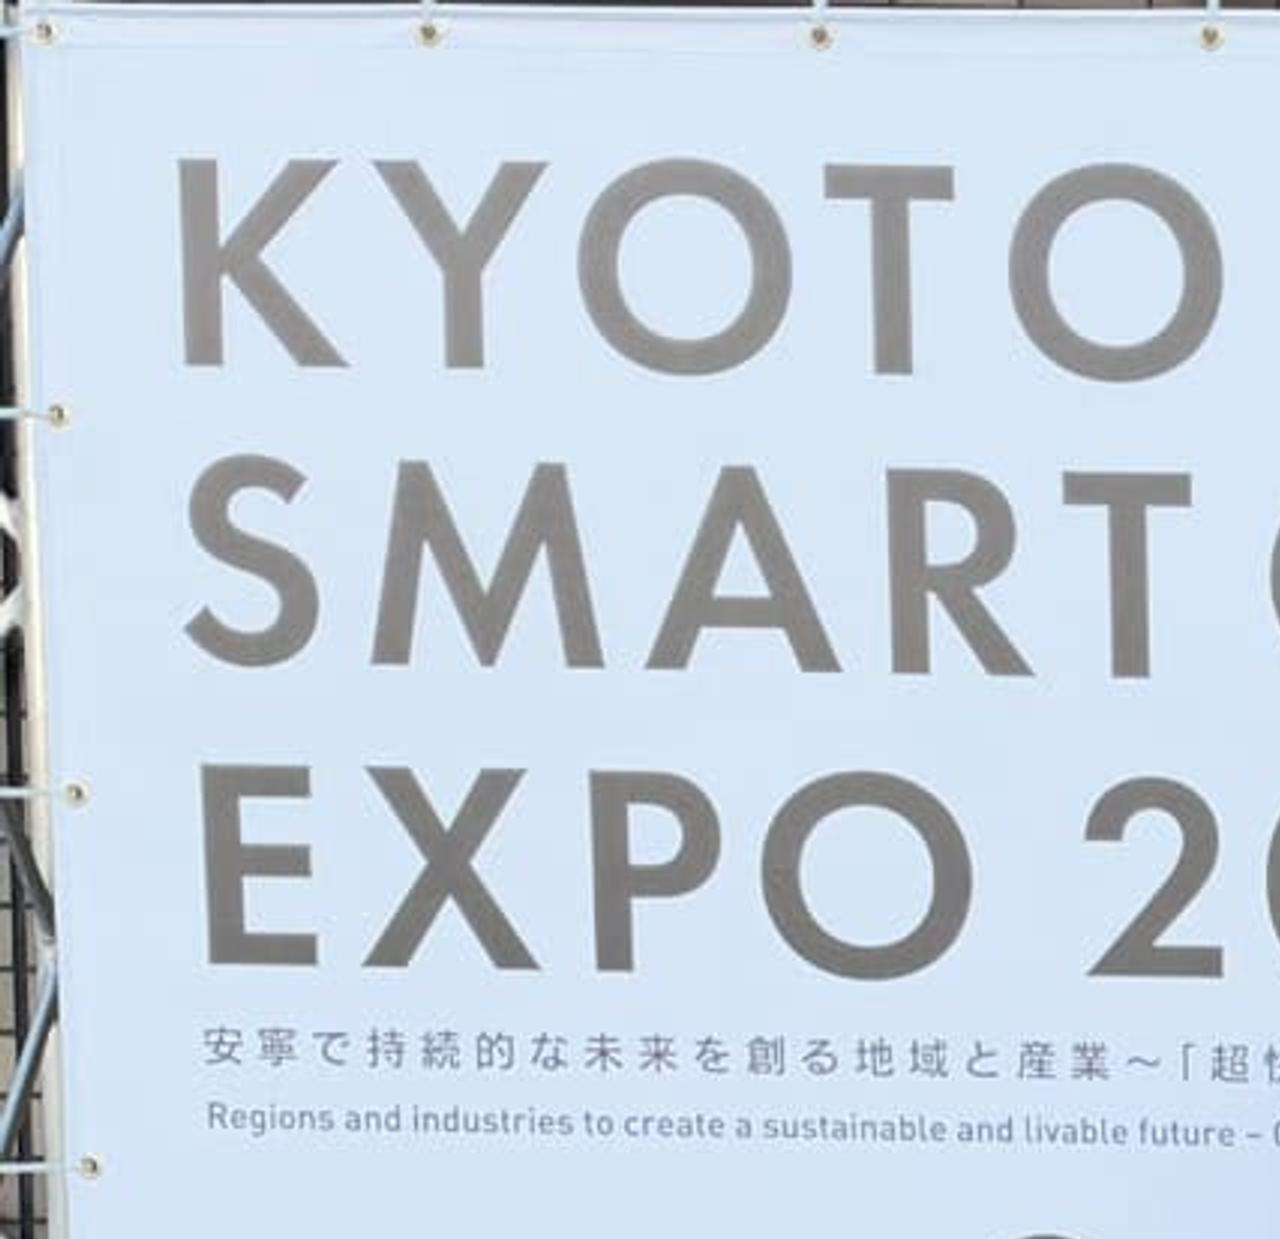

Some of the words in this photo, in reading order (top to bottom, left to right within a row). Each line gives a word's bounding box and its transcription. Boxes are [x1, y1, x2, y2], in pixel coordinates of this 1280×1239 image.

[177, 158, 1223, 382] KYOTO
[183, 453, 1192, 679] SMART
[199, 763, 974, 980] EXPO
[207, 1101, 334, 1139] Regions
[345, 1102, 401, 1133] and
[413, 1104, 572, 1136] industries
[585, 1110, 613, 1137] to
[623, 1113, 724, 1138] create
[735, 1118, 752, 1139] a
[762, 1112, 946, 1143] sustainable
[957, 1113, 1013, 1143] and
[1025, 1114, 1127, 1146] livable
[1139, 1116, 1234, 1147] future
